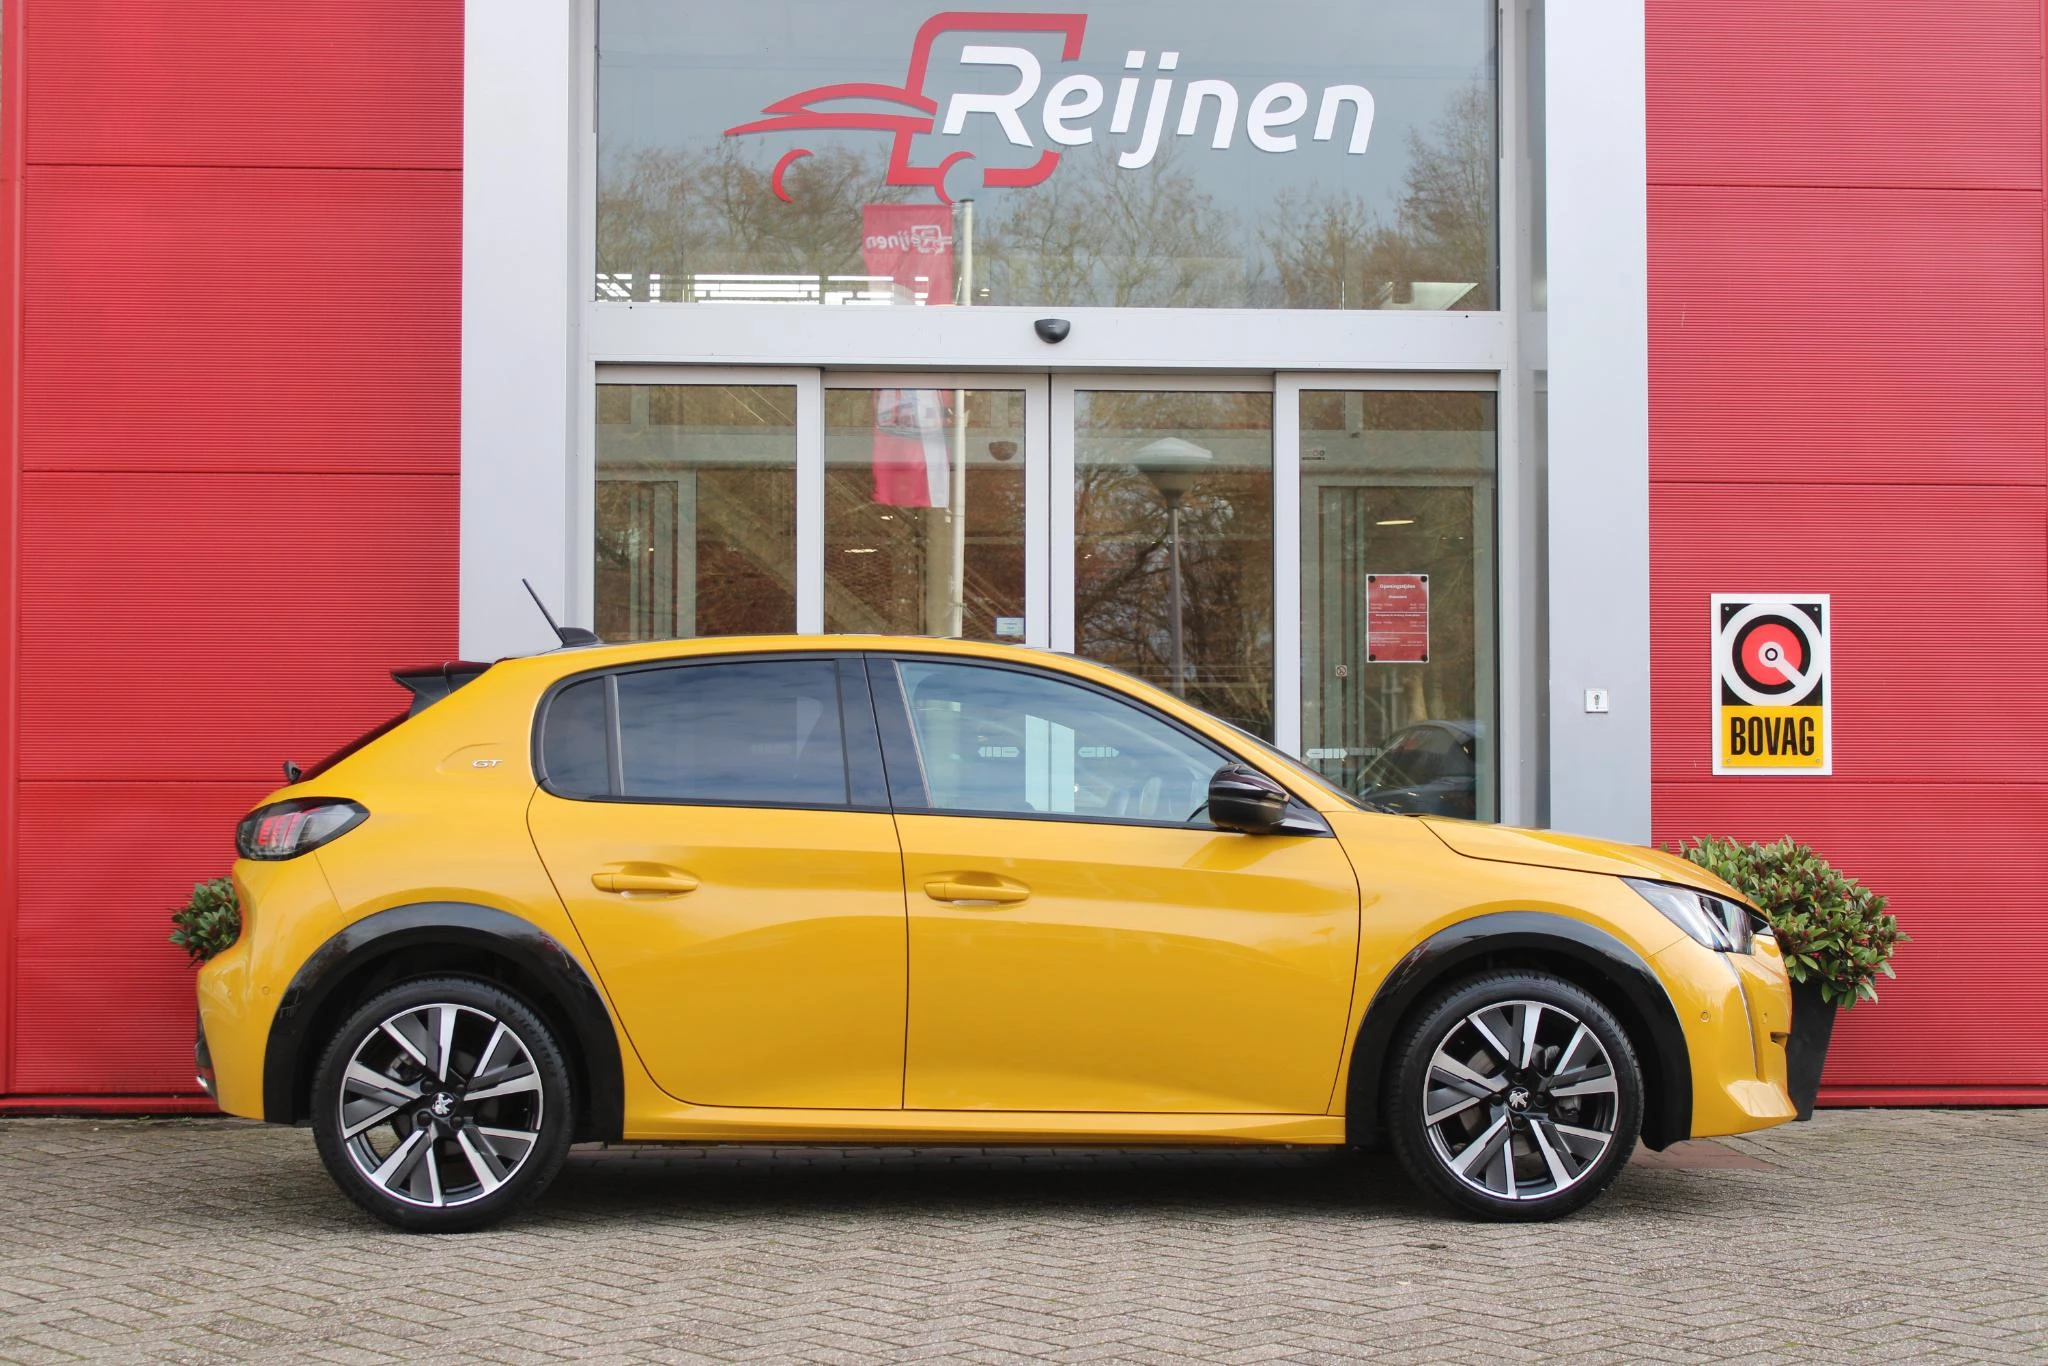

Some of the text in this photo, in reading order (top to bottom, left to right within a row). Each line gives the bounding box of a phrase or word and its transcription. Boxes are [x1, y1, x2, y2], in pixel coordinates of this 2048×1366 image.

[942, 45, 1375, 169] Reijnen
[1730, 716, 1815, 757] BOVAG
[472, 759, 503, 769] GT
